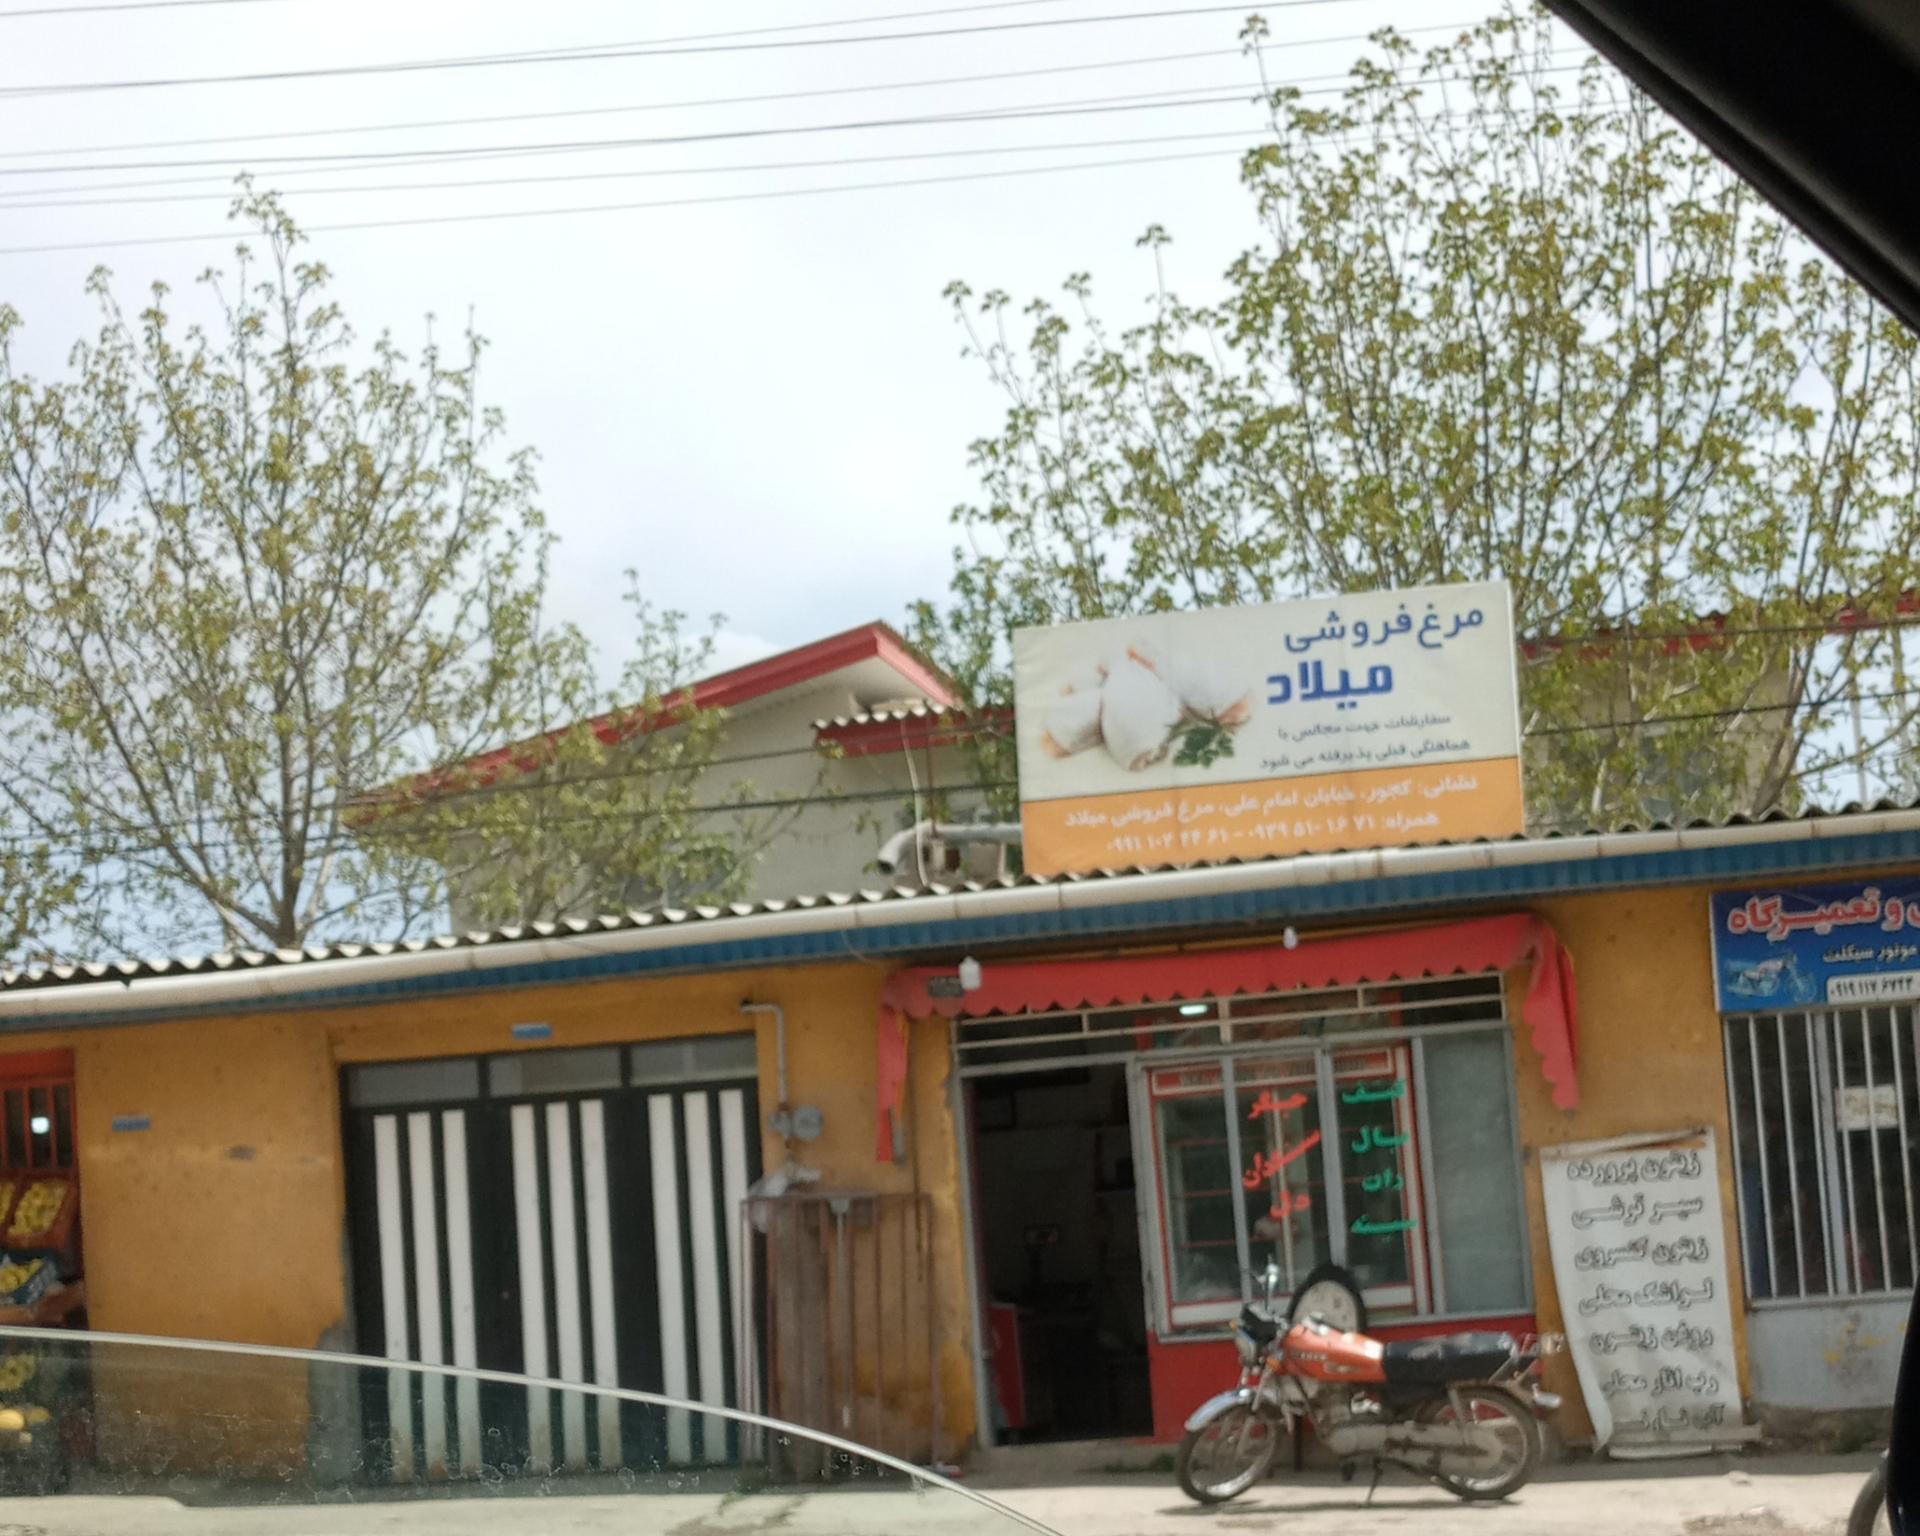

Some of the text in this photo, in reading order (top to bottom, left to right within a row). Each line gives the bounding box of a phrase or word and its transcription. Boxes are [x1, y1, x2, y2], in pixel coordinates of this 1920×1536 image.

[1286, 603, 1484, 652] مرغ فروشی
[1267, 660, 1393, 711] میلاد
[1292, 723, 1341, 742] مجالس
[1346, 721, 1380, 735] جهت
[1384, 713, 1451, 730] سفارشات
[1375, 743, 1407, 761] قبلی
[1410, 738, 1471, 759] هماهنگی
[1262, 790, 1298, 816] امام
[1303, 785, 1355, 808] خیابان
[1065, 810, 1107, 827] میلاد
[1111, 800, 1173, 828] فروشی
[1177, 799, 1215, 823] مرغ
[1727, 887, 1881, 942] تعمیرگاه
[1823, 943, 1918, 964] موتور سیکلت
[1351, 1126, 1409, 1156] بال
[1361, 1167, 1405, 1193] ران
[1567, 1150, 1702, 1187] زیتون پرورده
[1269, 1190, 1312, 1220] دل
[1571, 1192, 1705, 1230] سیر ترشی
[1652, 1235, 1710, 1265] زیتون
[1578, 1277, 1714, 1316] لواشک محلی
[1589, 1319, 1715, 1355] روغن زیتون
[1650, 1365, 1683, 1397] انار
[1685, 1370, 1720, 1396] رب
